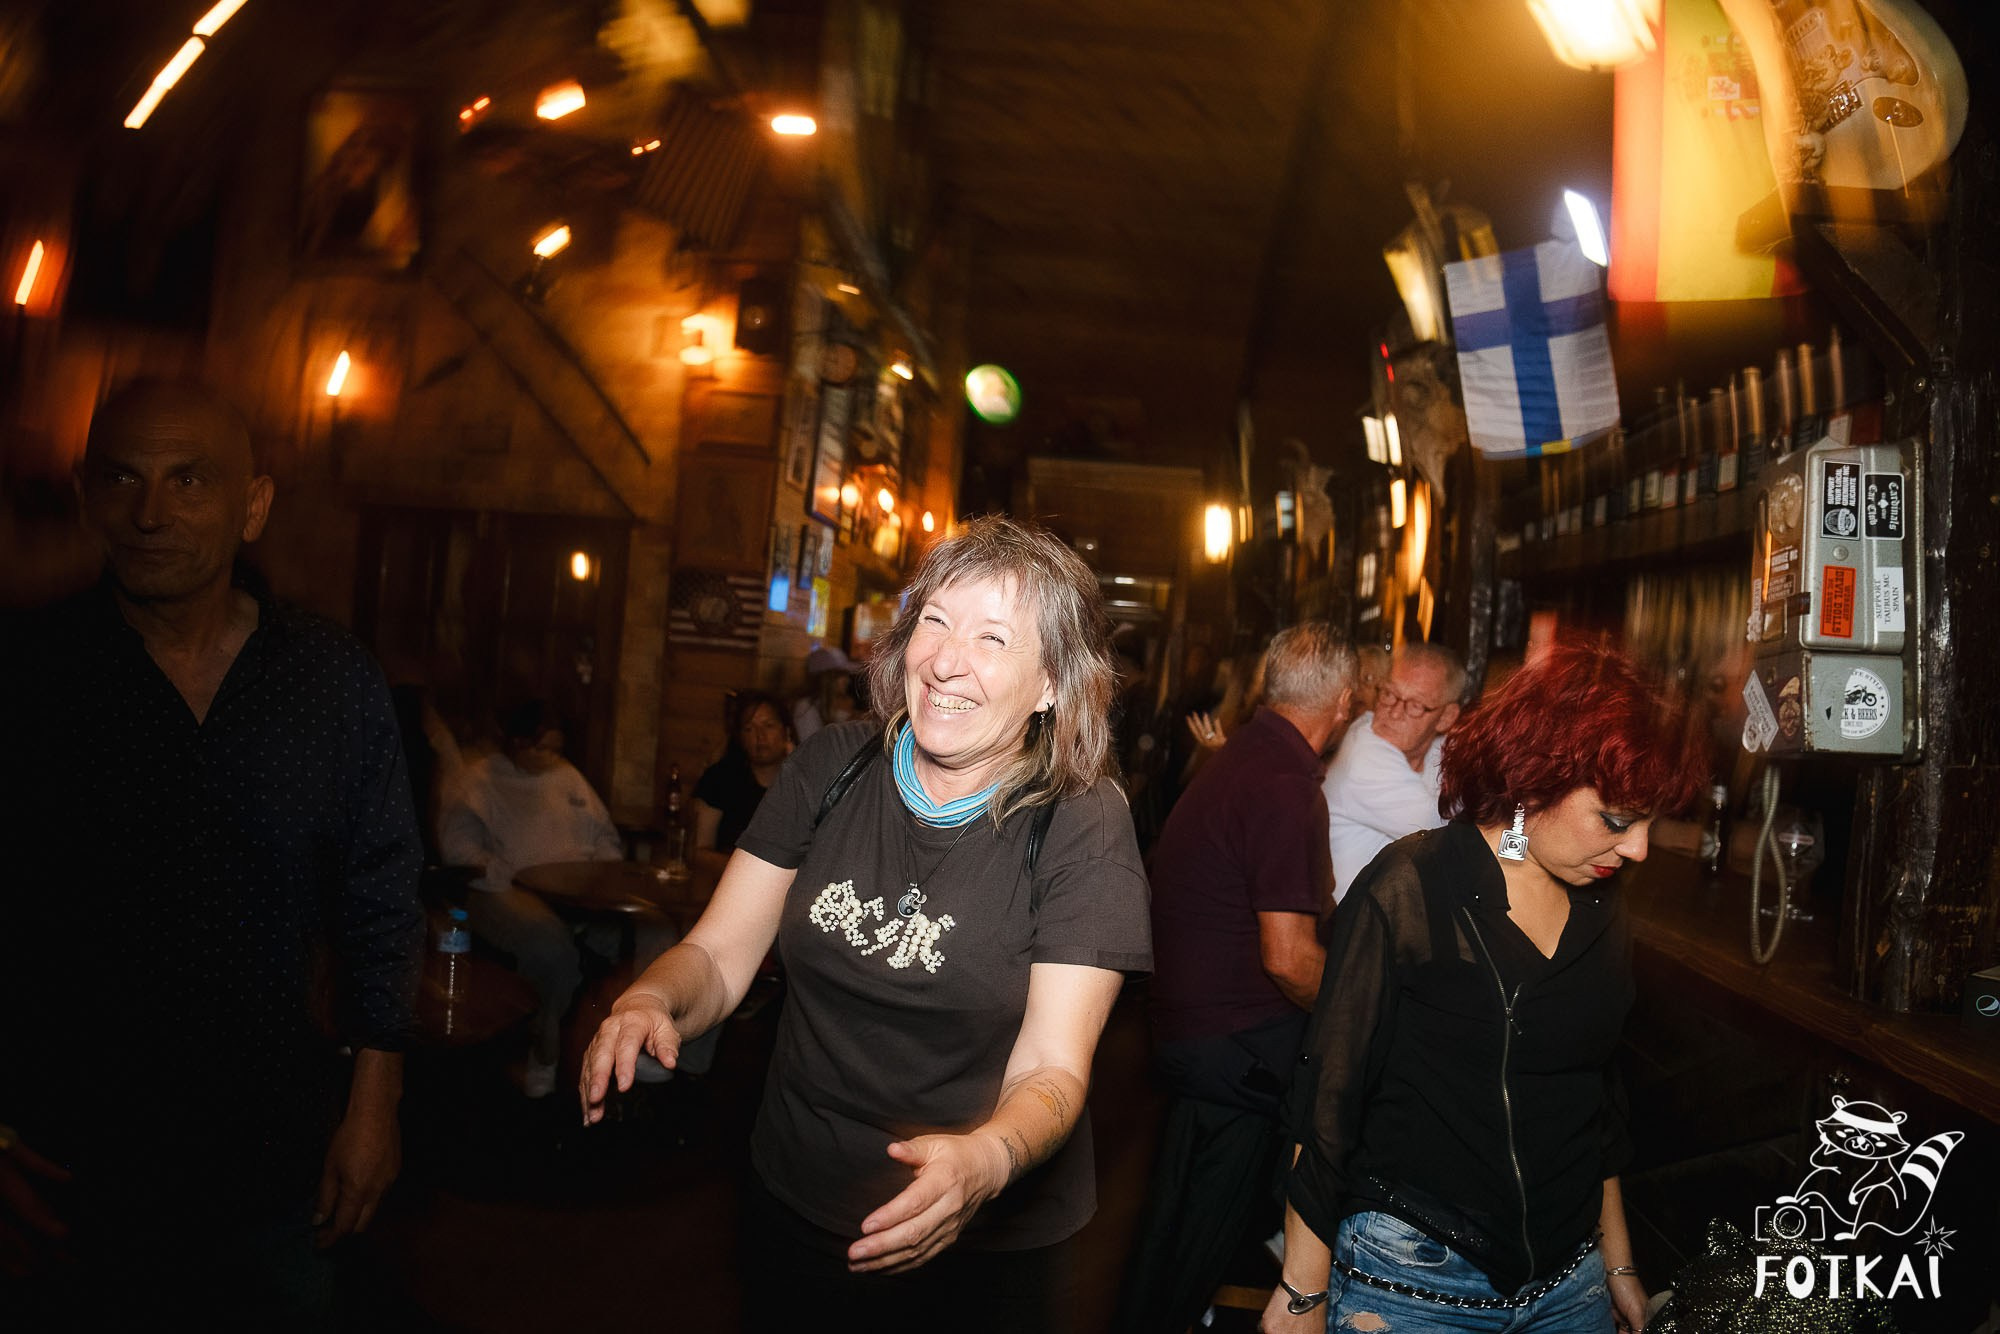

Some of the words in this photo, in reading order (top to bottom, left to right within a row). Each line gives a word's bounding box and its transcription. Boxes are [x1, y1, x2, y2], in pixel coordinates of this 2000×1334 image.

[1867, 483, 1878, 501] Car
[1888, 481, 1901, 531] Cardinals
[1867, 503, 1878, 526] Club
[1834, 568, 1844, 600] DEVIL
[1883, 573, 1890, 588] MC
[1874, 580, 1882, 619] SUPPORT
[1883, 590, 1891, 625] TAURUS
[1832, 601, 1842, 633] DOLLS
[1857, 708, 1878, 720] BEERS
